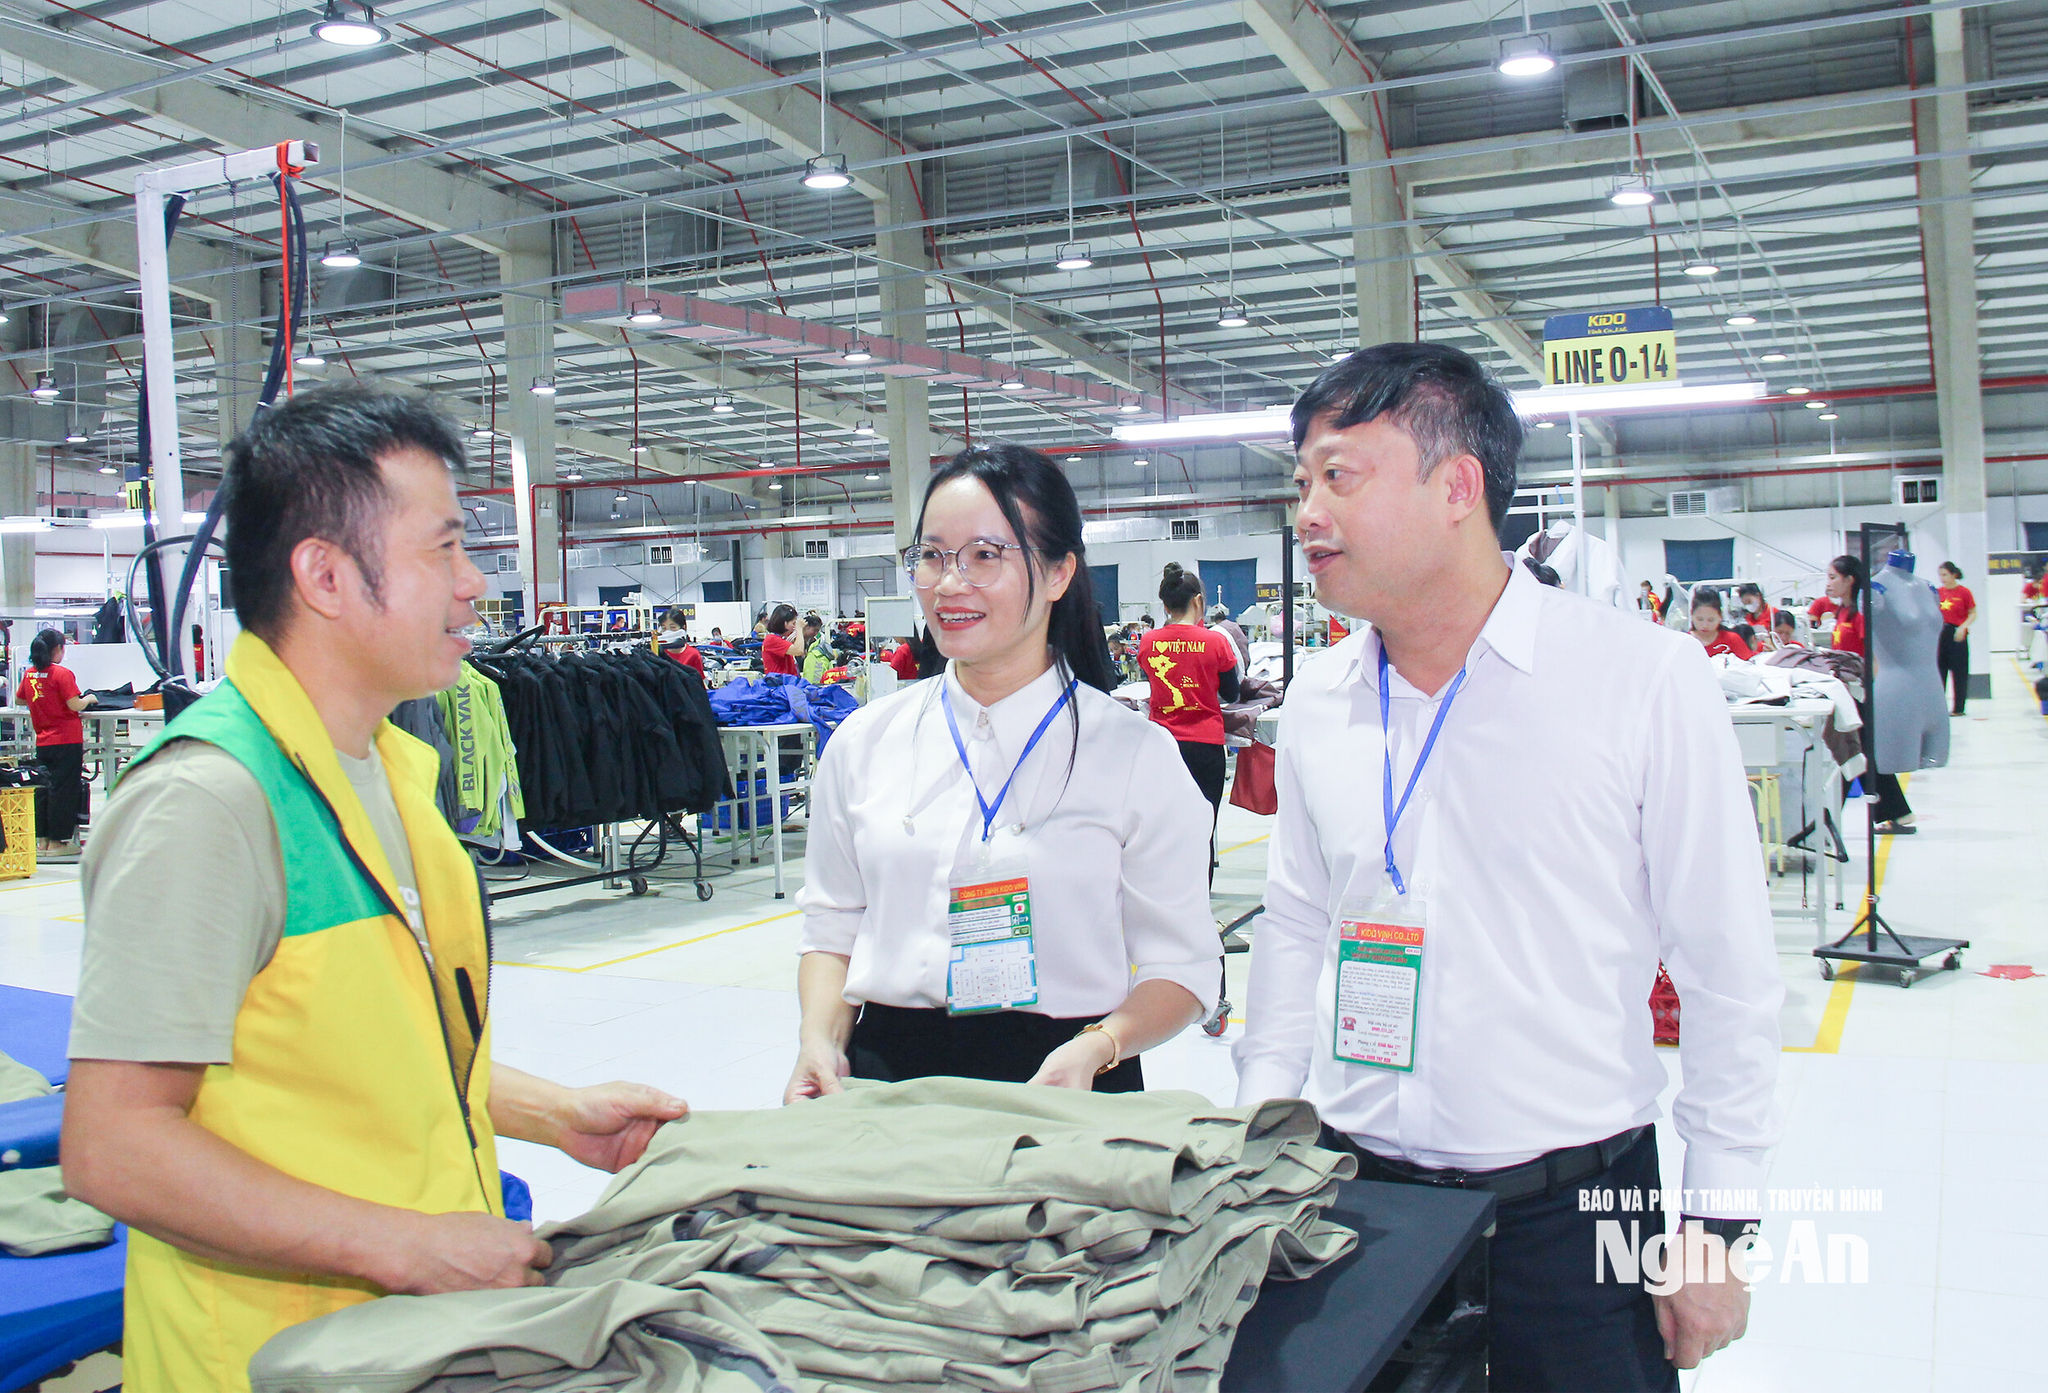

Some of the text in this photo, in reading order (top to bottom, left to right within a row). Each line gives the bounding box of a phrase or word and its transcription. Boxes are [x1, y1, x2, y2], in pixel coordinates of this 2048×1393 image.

[1552, 348, 1604, 385] LINE
[1152, 640, 1156, 652] I
[1187, 640, 1206, 653] NAM
